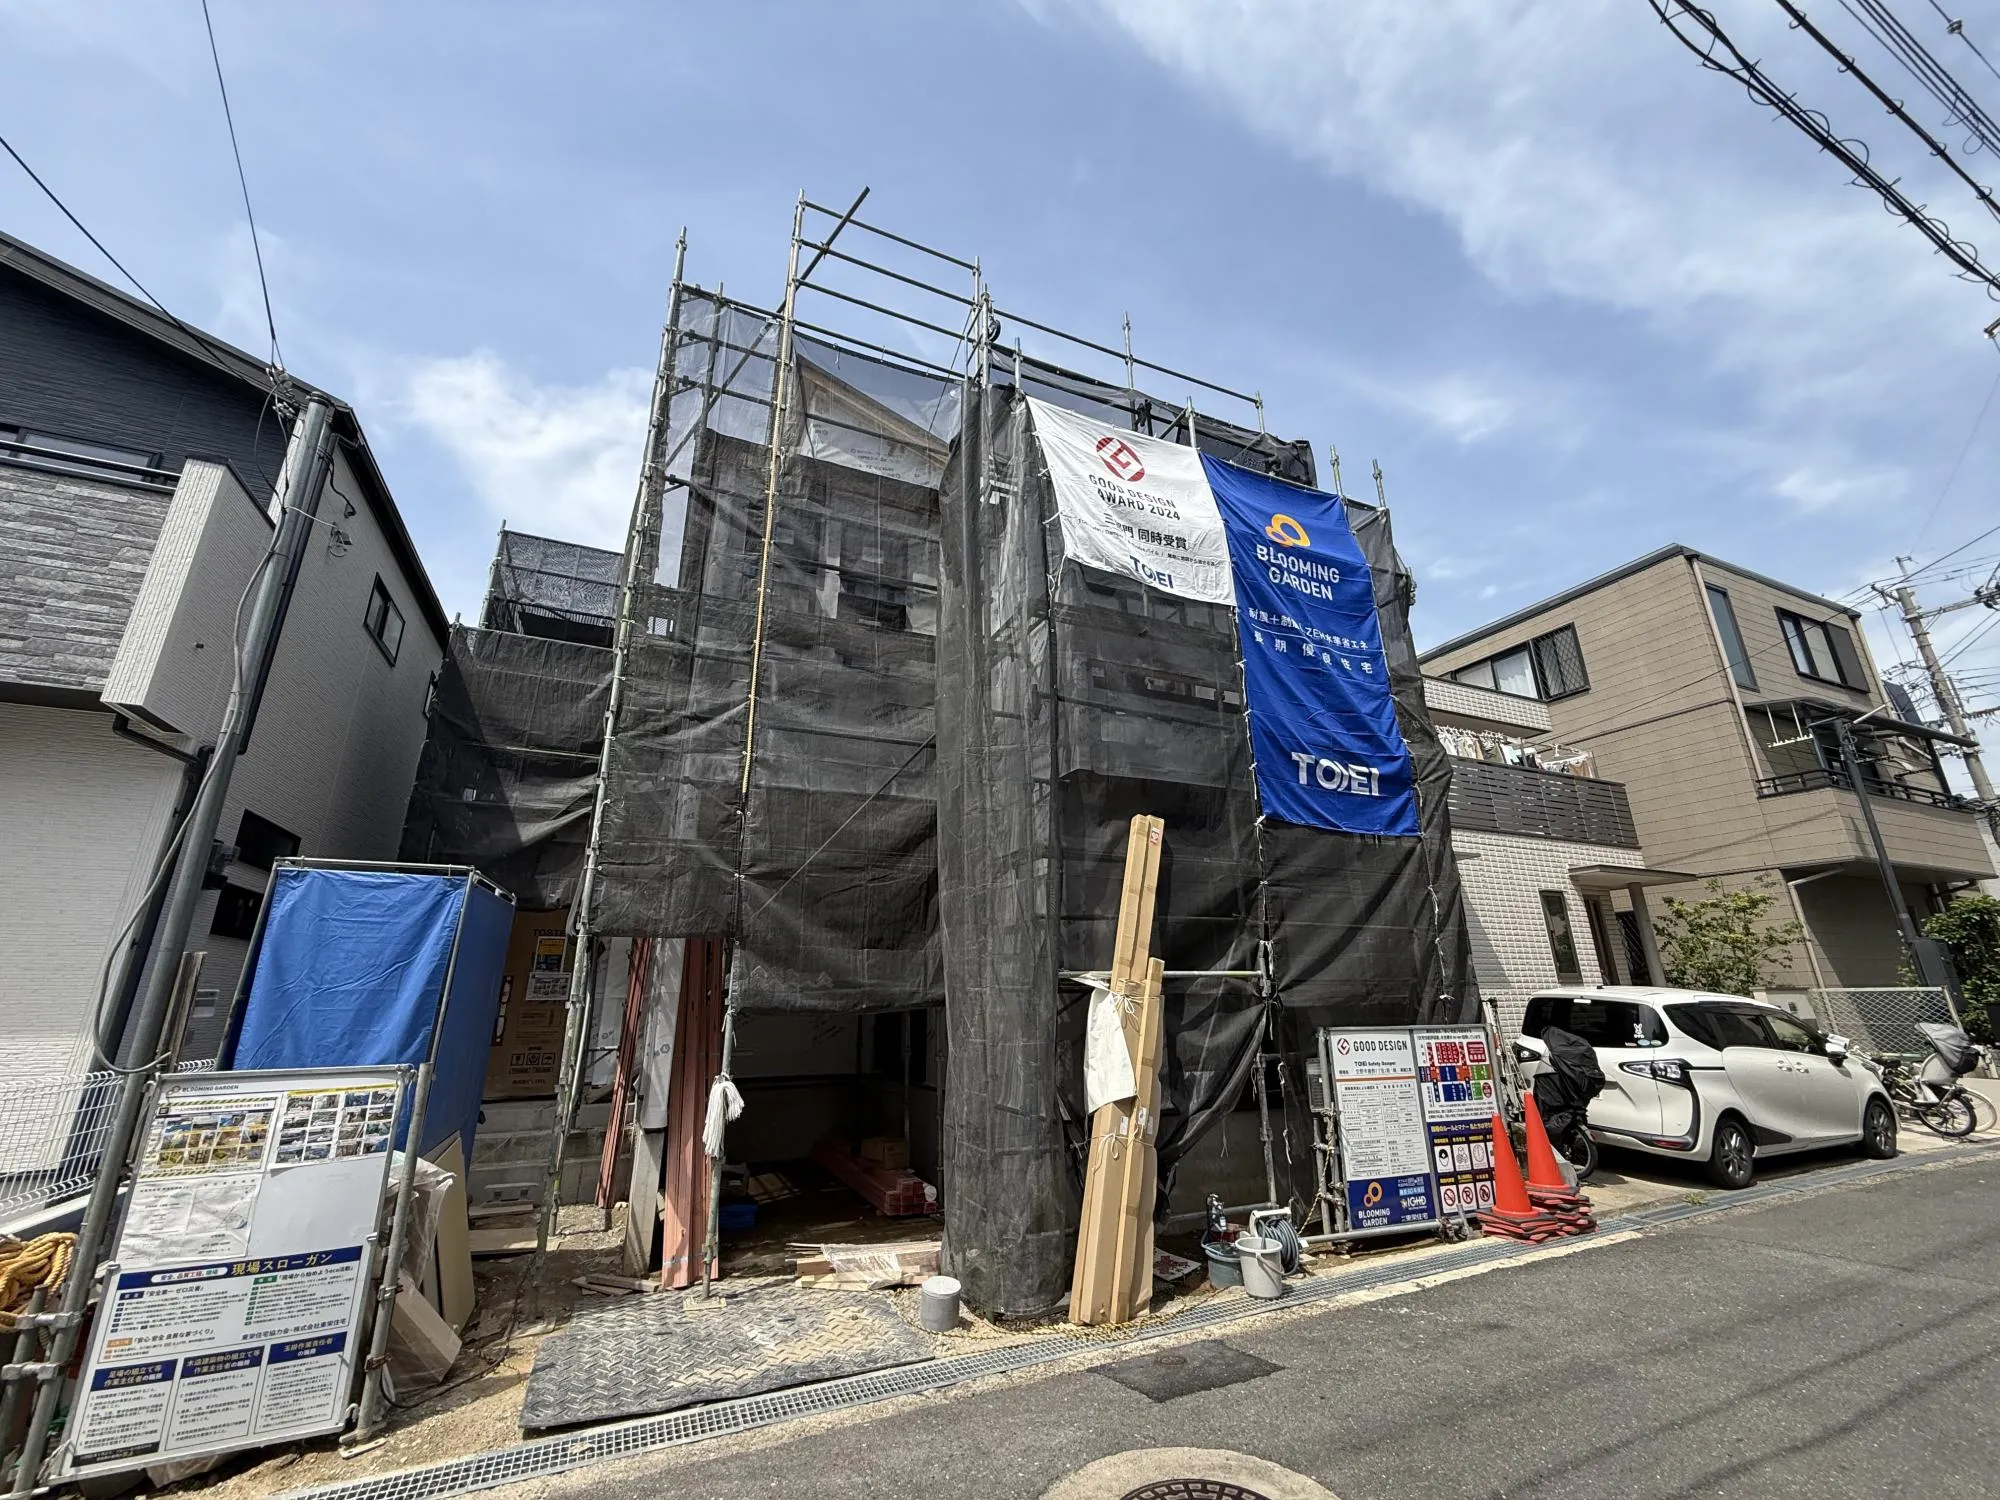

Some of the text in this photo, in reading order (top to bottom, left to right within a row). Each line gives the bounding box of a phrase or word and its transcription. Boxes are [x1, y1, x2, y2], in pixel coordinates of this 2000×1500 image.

[1089, 474, 1177, 509] GOOD DESIGN
[1097, 489, 1181, 521] AWARD 2024
[1138, 528, 1189, 551] 同時受賞
[1129, 555, 1174, 589] TOEI
[1256, 544, 1340, 583] BLOOMING
[1268, 566, 1333, 601] GARDEN
[1291, 751, 1380, 796] TOEI
[532, 929, 566, 937] TOSTE
[1353, 1040, 1408, 1052] GOOD DESIGN
[1358, 1208, 1391, 1219] BLOOMING
[1362, 1217, 1388, 1227] GARDEN
[231, 1253, 333, 1276] 現場スローガン
